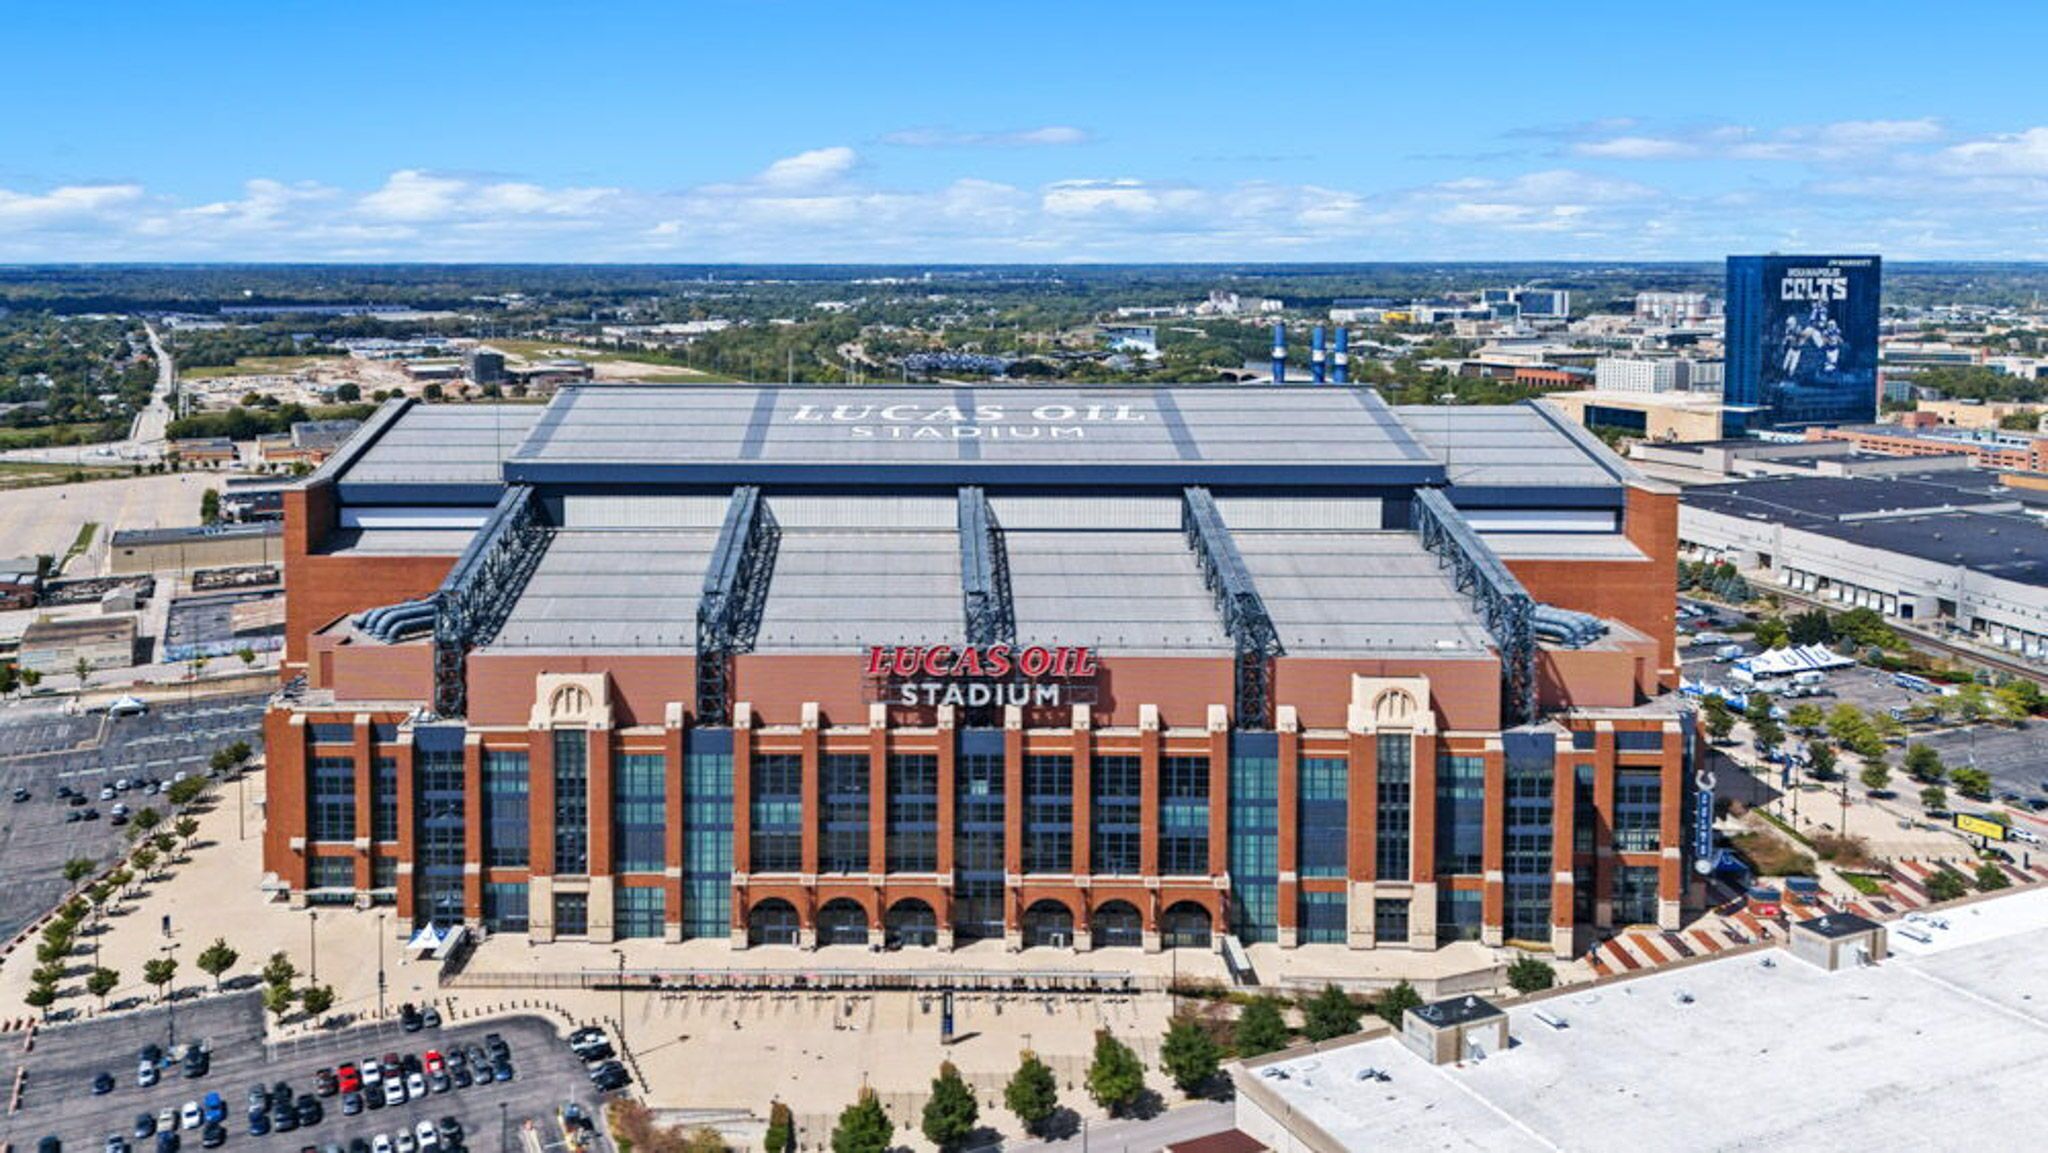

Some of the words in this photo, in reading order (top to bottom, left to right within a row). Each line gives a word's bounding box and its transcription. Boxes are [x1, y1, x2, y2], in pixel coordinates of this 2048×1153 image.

[1781, 277, 1848, 300] COLTS
[791, 404, 1004, 421] LUCAS
[1031, 403, 1146, 422] OIL
[851, 425, 1085, 441] STADIUM
[866, 643, 1012, 677] LUCAS
[1019, 645, 1098, 677] OIL
[901, 683, 1060, 706] STADIUM
